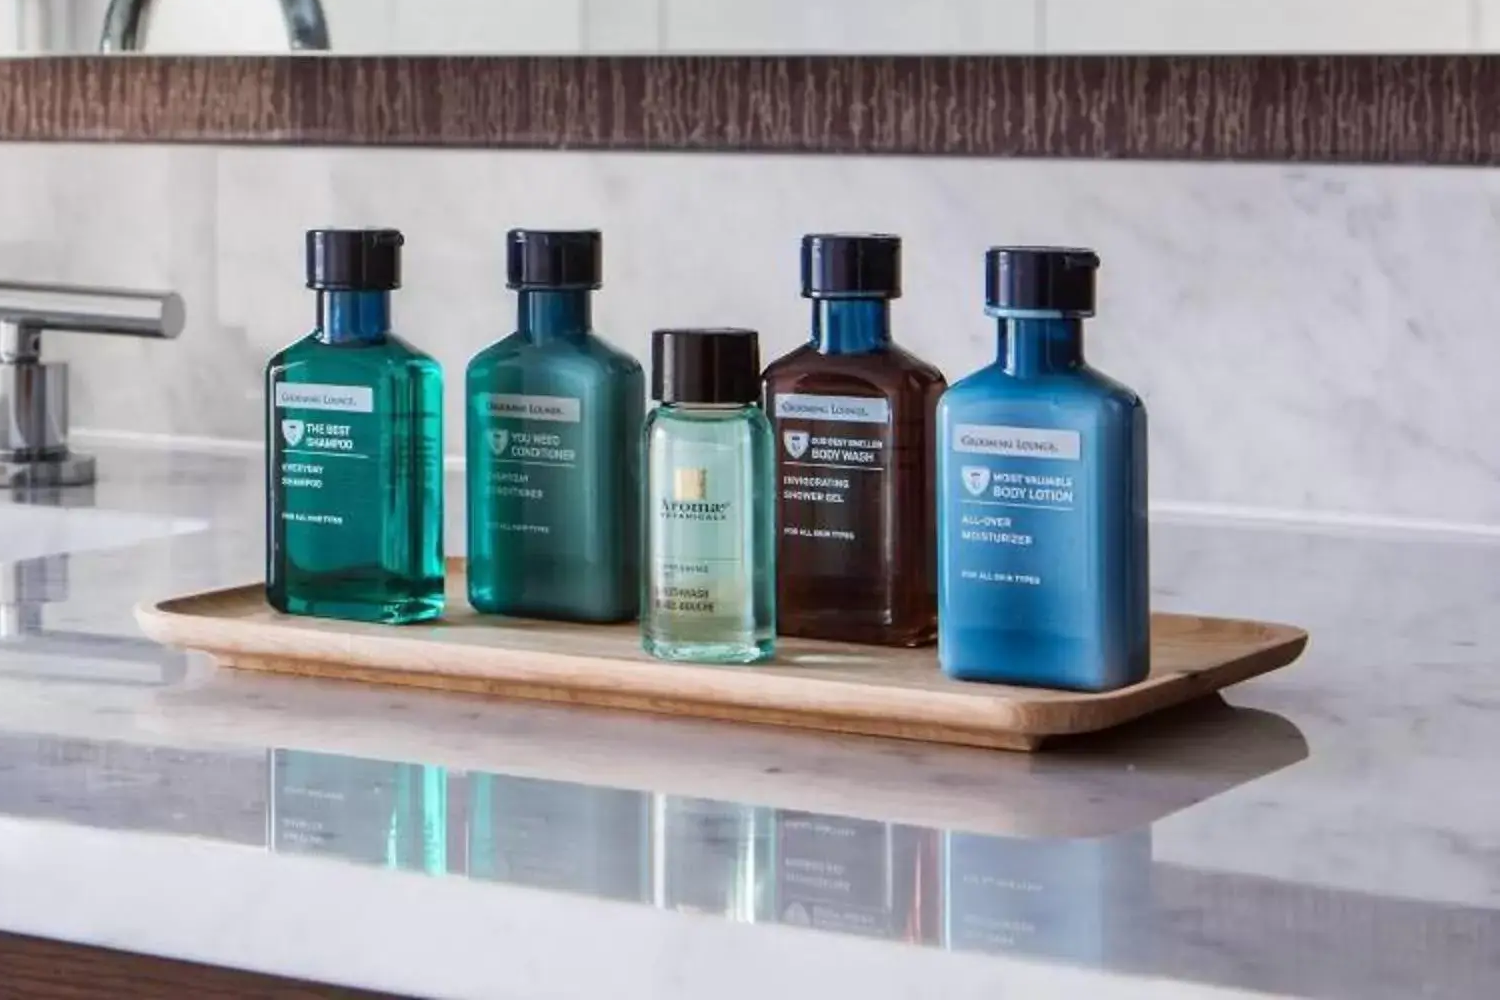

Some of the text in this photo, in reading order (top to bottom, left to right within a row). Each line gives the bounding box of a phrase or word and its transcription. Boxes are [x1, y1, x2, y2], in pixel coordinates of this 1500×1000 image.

[306, 423, 351, 436] THE BEST
[306, 438, 353, 450] SHAMPOO
[511, 432, 561, 446] YOU NEED
[511, 446, 576, 461] CONDITIONER
[812, 449, 875, 463] BODY WASH
[282, 478, 323, 489] SHAMPOO
[784, 476, 850, 489] INVIGORATING
[993, 473, 1073, 488] MOST VALUABLE
[784, 492, 844, 503] SHOWER GEL
[993, 486, 1073, 503] BODY LOTION
[962, 516, 1011, 528] ALL-OVER
[962, 531, 1033, 545] MOISTURIZER
[979, 571, 992, 581] ALL
[1015, 573, 1041, 585] TYPES
